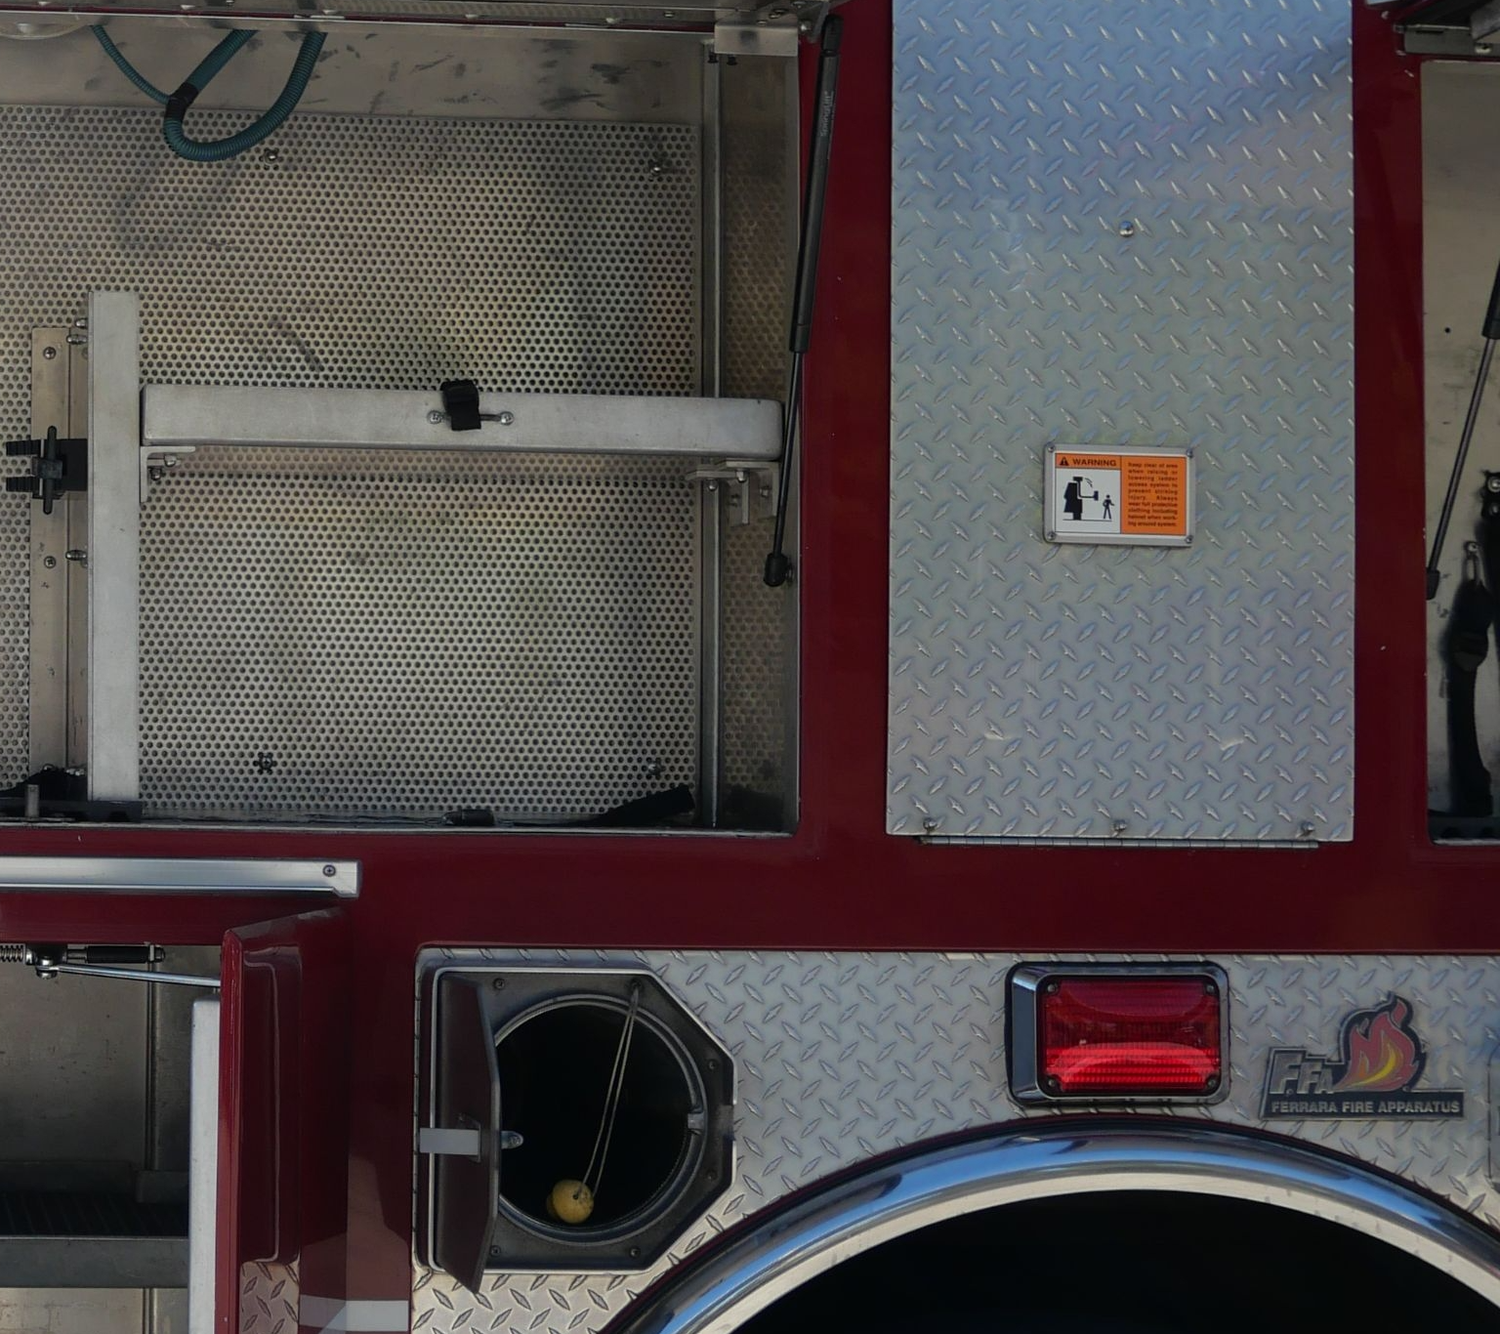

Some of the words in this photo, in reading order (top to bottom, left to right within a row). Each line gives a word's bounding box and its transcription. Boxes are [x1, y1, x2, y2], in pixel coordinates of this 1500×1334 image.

[1072, 459, 1116, 467] WARNING
[1272, 1101, 1336, 1113] FERRARA
[1342, 1101, 1374, 1113] FIRE
[1378, 1101, 1460, 1113] APPARATUS
